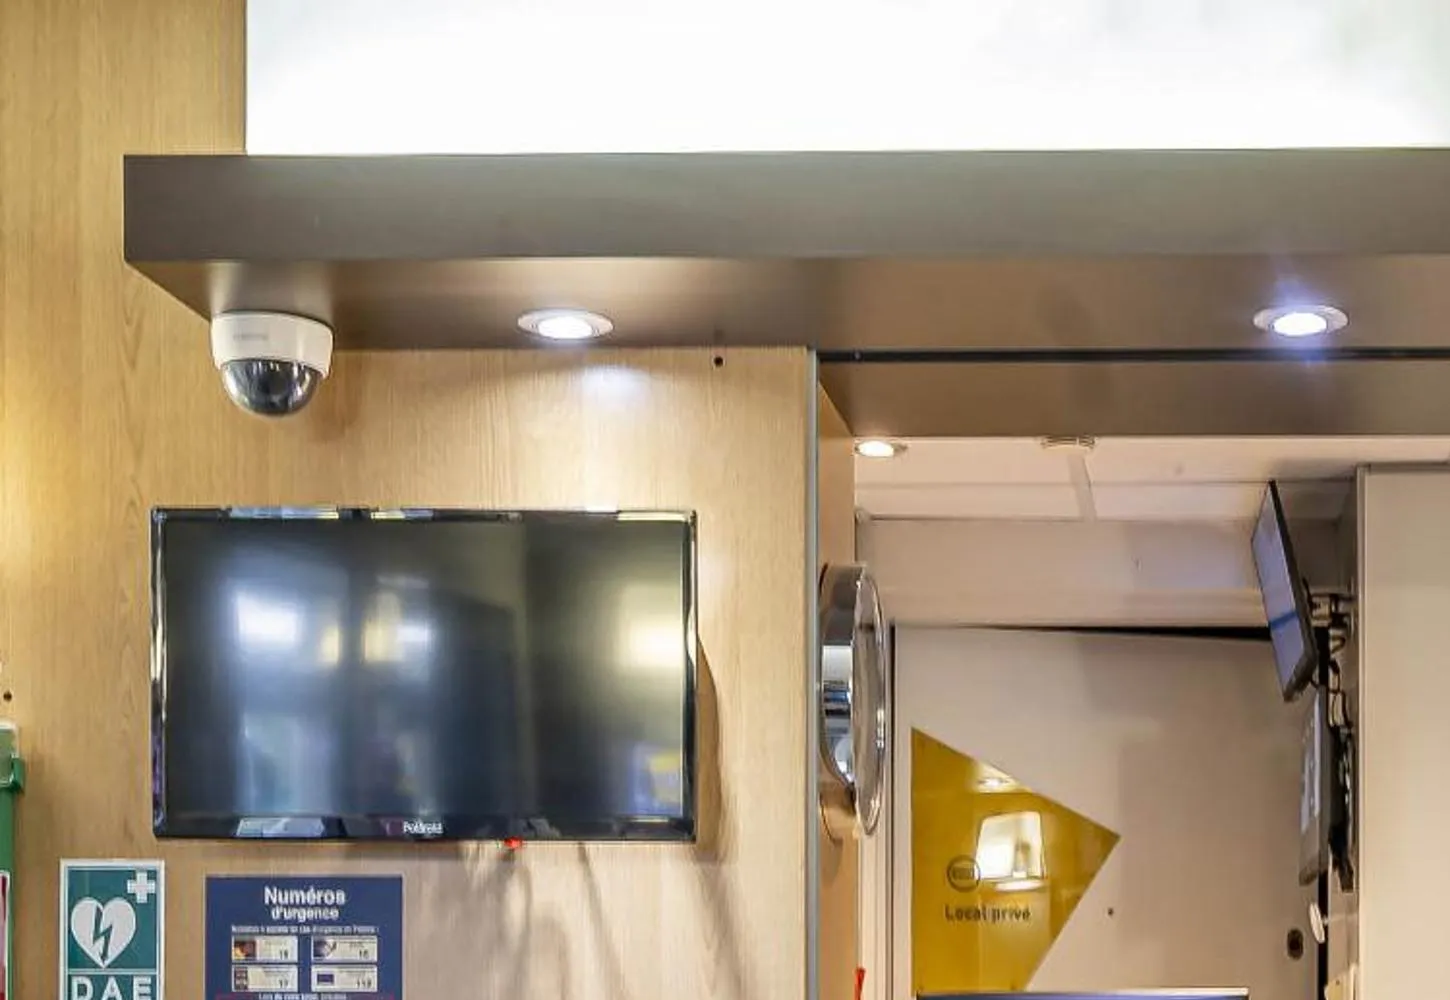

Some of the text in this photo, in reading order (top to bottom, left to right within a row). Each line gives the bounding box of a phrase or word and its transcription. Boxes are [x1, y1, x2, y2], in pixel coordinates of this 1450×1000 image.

[264, 886, 346, 906] Numéros
[271, 904, 340, 923] d'urgence
[944, 904, 986, 921] Local
